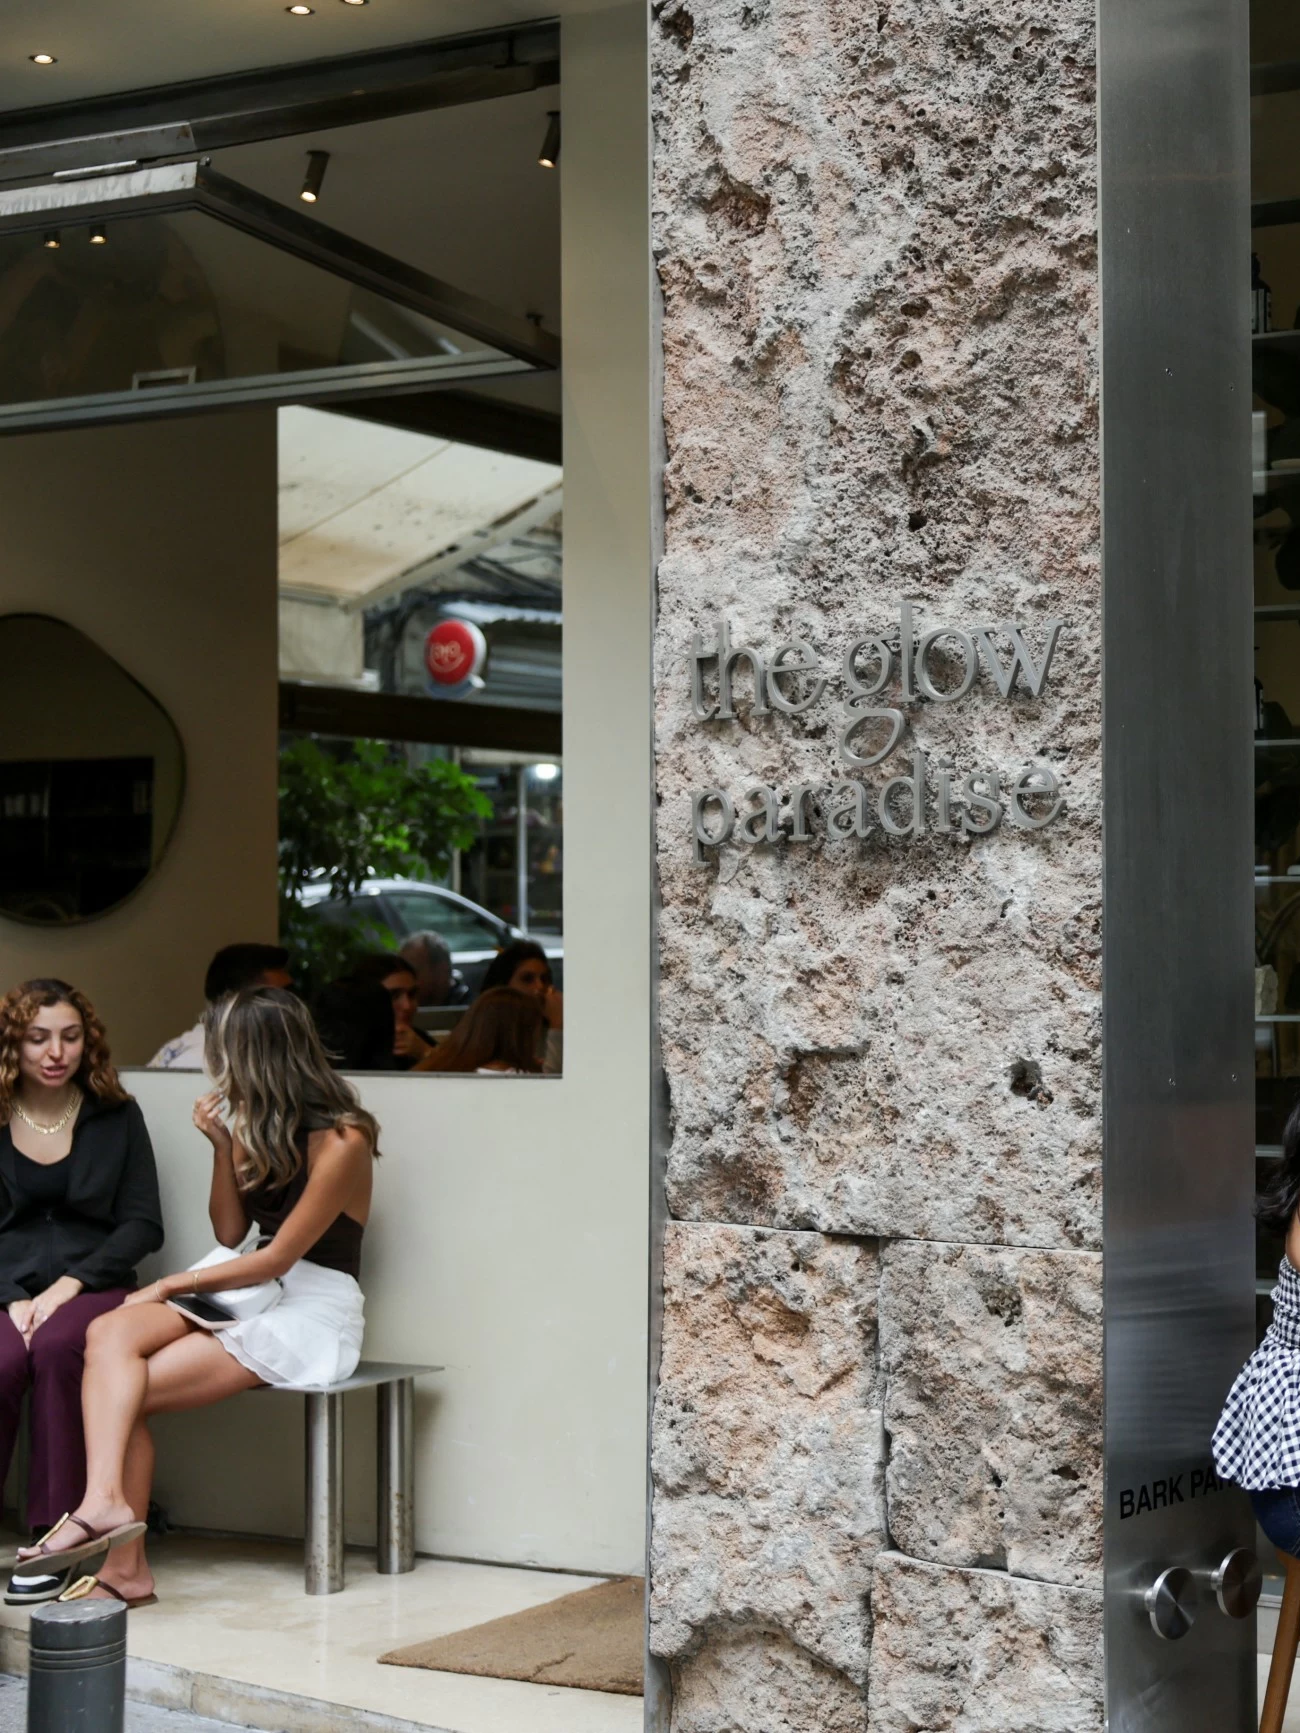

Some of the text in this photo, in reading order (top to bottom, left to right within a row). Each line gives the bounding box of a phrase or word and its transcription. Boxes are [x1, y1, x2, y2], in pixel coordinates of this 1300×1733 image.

[687, 600, 1073, 768] the glow
[687, 750, 1067, 868] paradise
[1120, 1474, 1184, 1520] BARK
